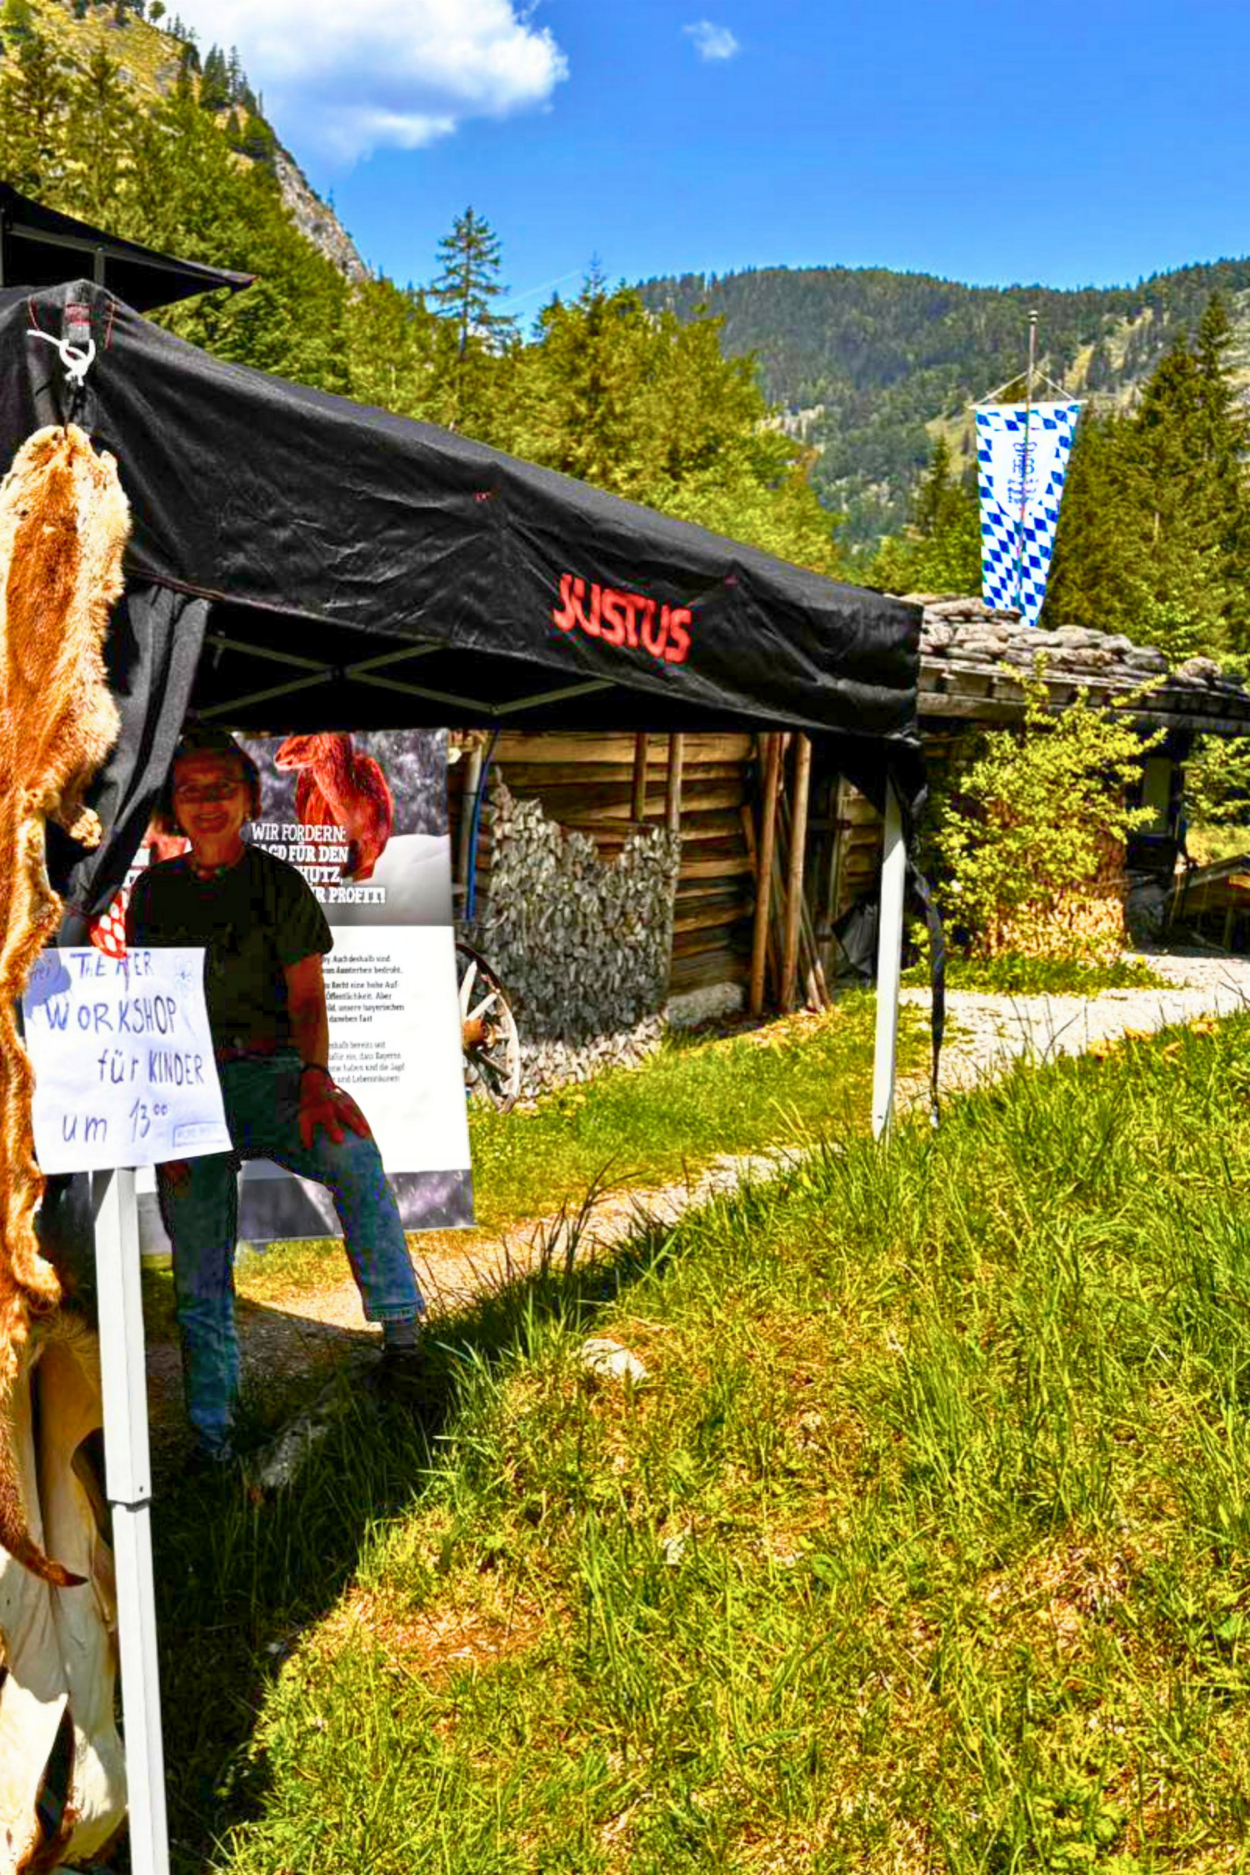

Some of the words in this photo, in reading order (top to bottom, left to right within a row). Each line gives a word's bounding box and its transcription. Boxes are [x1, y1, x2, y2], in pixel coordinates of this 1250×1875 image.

[553, 573, 692, 663] JUSTUS
[251, 823, 279, 841] WIR
[282, 824, 346, 843] FORDERN:
[288, 841, 317, 862] FÜR
[318, 845, 348, 863] DEN
[328, 886, 386, 904] PROFIT!
[45, 994, 177, 1035] WORKSHOP
[97, 1048, 139, 1084] für
[149, 1049, 206, 1086] KINDER
[61, 1113, 108, 1143] um
